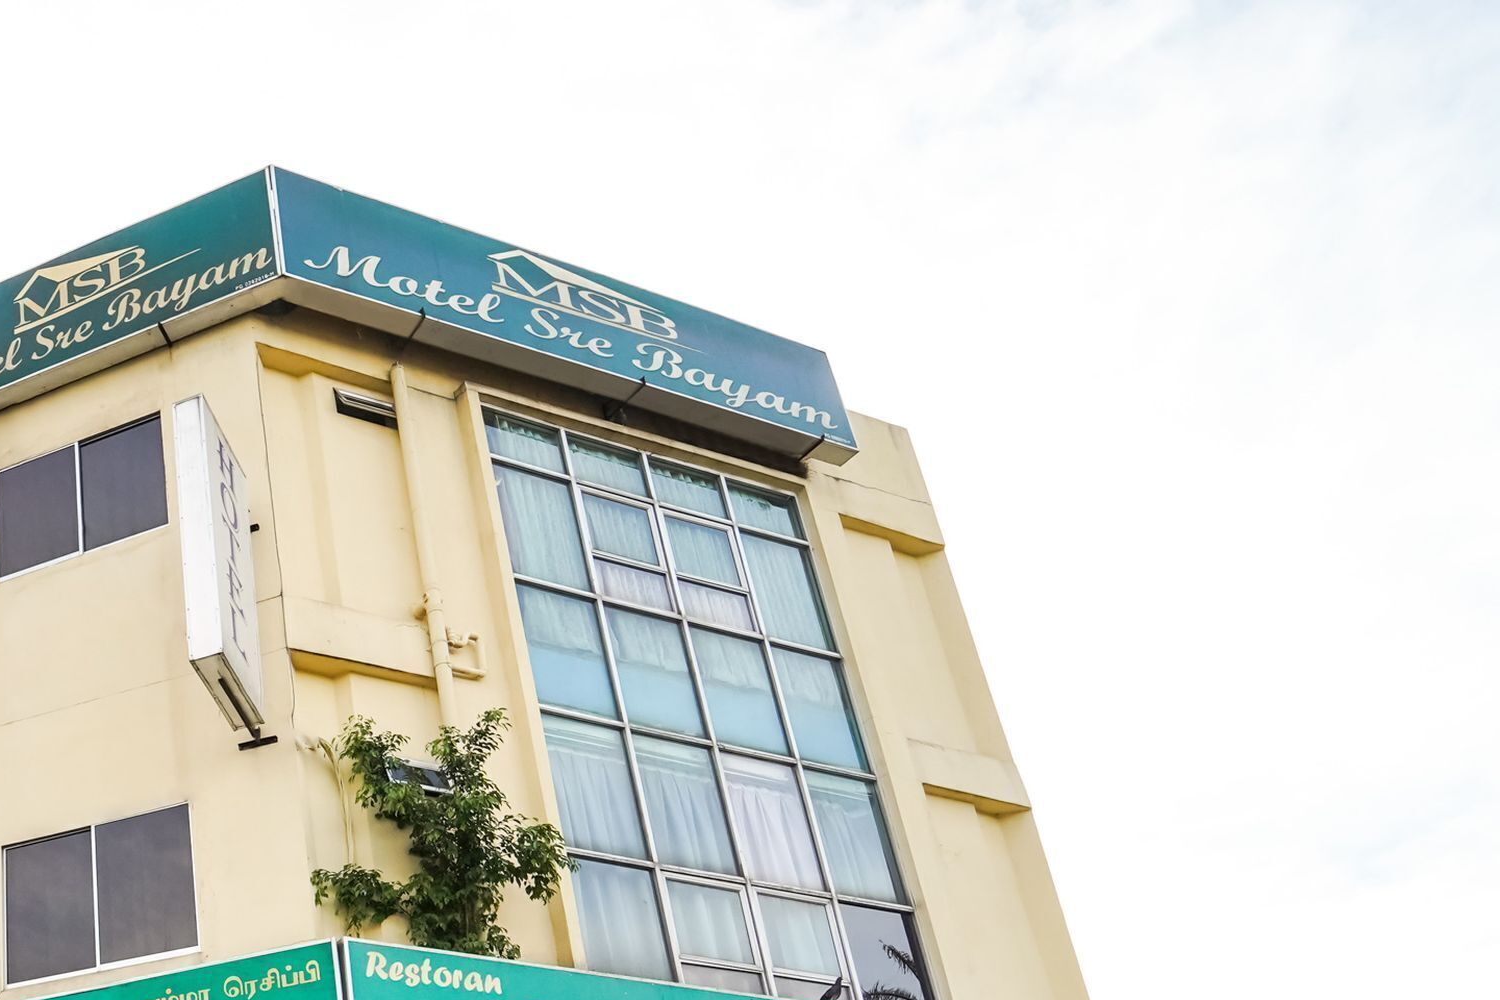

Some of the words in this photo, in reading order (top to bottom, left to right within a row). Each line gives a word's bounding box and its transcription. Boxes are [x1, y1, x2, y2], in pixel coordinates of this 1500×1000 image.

[13, 247, 146, 327] MSB
[31, 321, 94, 361] Sre
[102, 247, 273, 332] Bayam
[488, 252, 679, 340] MSB
[303, 246, 505, 323] Motel
[523, 308, 614, 358] Sre
[631, 343, 839, 430] Bayam
[223, 959, 321, 1000] ரெசிப்பி
[365, 951, 503, 995] Restoran
